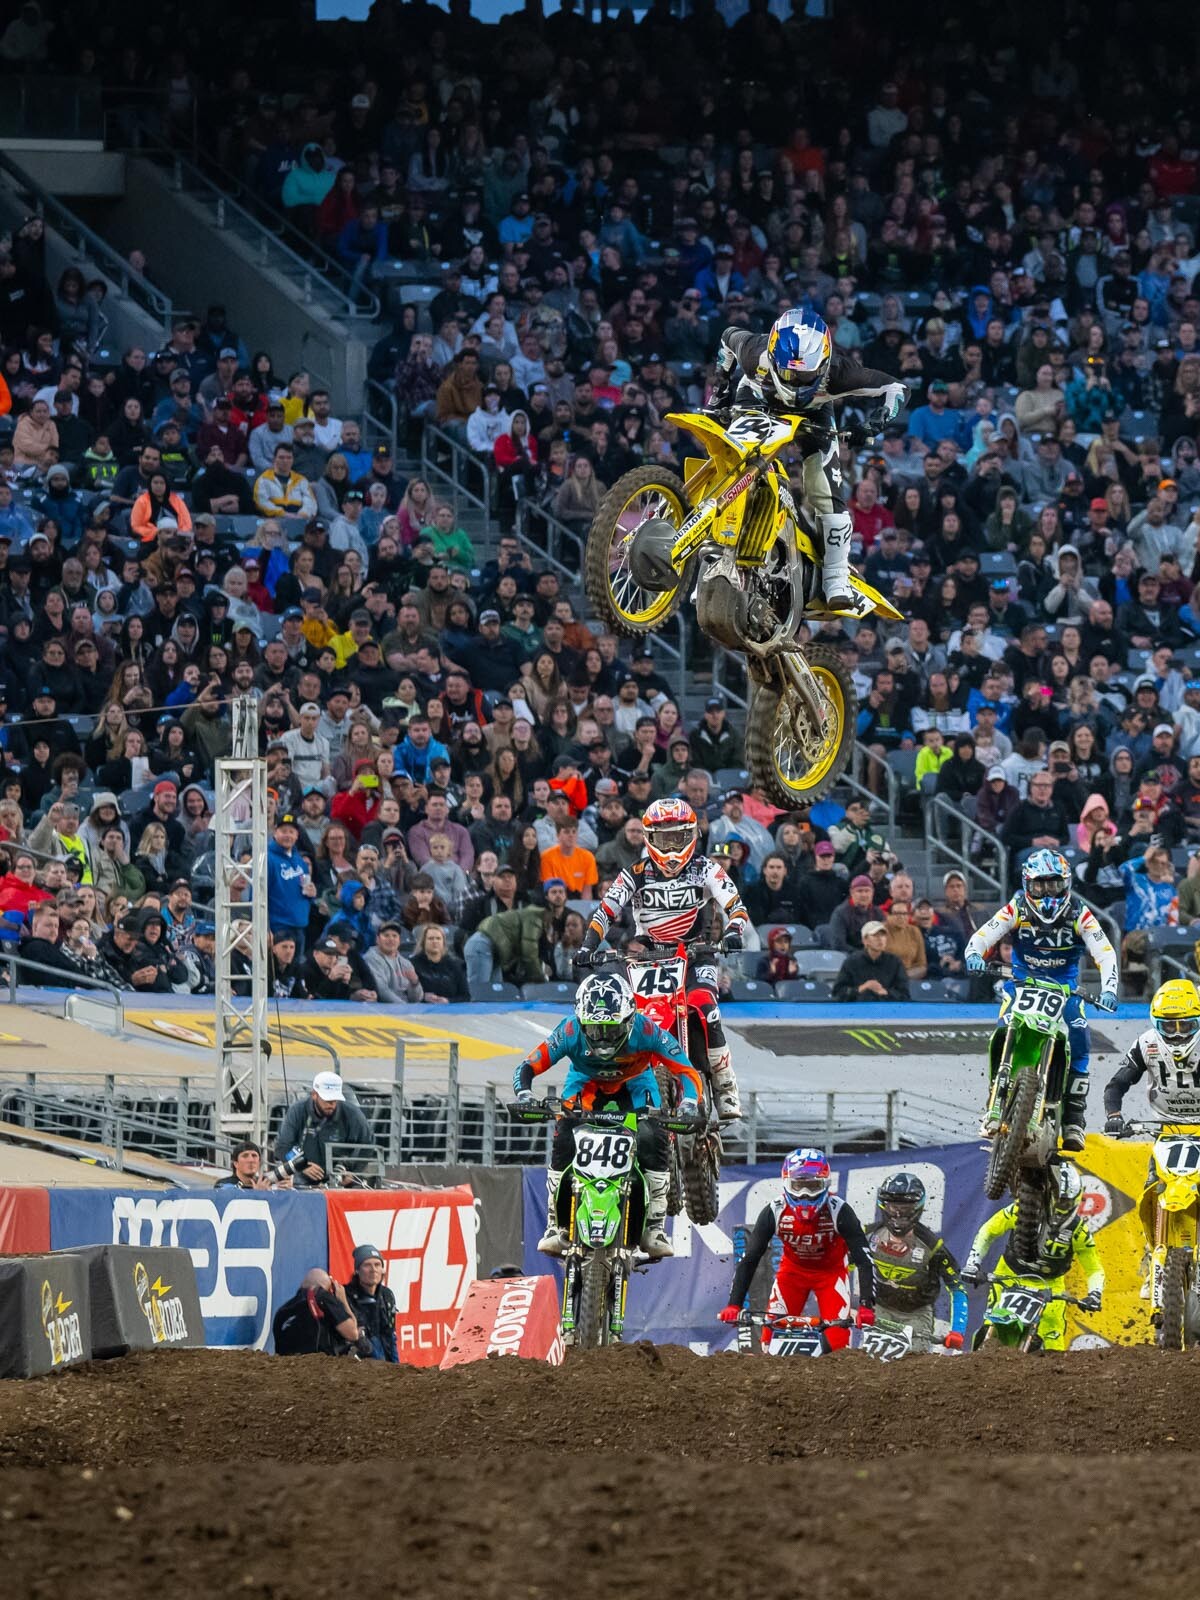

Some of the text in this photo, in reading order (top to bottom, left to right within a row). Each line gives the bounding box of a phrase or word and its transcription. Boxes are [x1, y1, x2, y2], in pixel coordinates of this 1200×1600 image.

[731, 418, 777, 440] 94
[672, 511, 703, 542] DUNLOP
[637, 969, 680, 995] 45
[1018, 990, 1063, 1018] 519
[577, 1136, 630, 1169] 848
[1001, 1292, 1042, 1322] 141
[401, 1322, 456, 1350] ACIN
